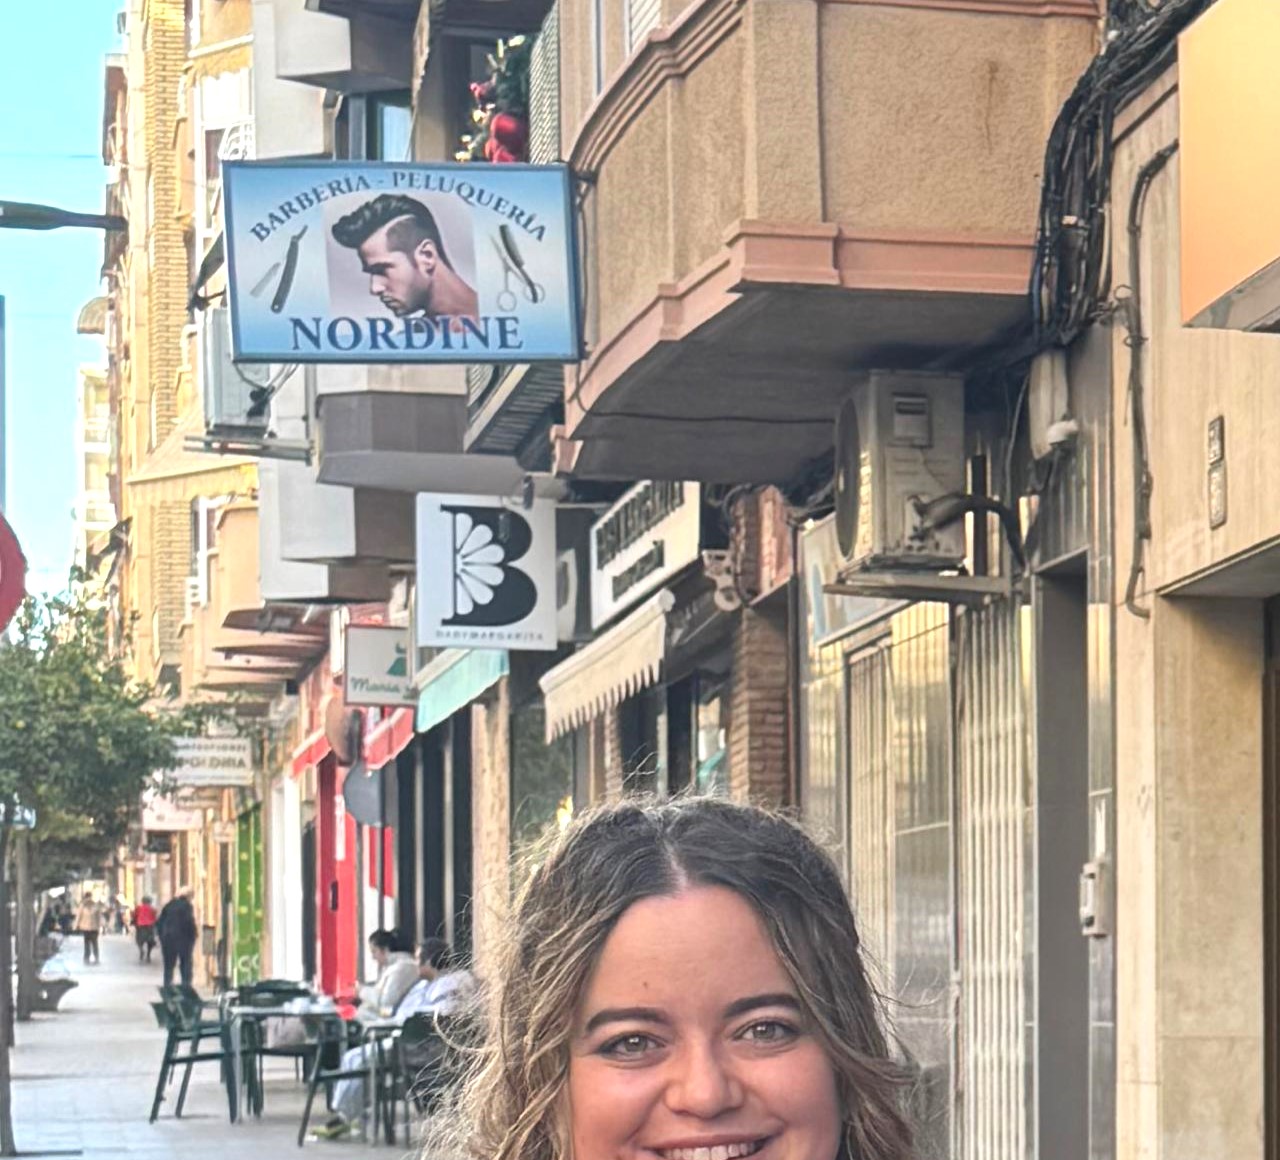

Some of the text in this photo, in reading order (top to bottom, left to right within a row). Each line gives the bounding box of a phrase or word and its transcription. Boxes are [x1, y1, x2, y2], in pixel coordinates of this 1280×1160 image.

[251, 175, 371, 242] BARBERÍA
[392, 171, 548, 243] PELUQUERÍA
[290, 316, 523, 350] NORDINE
